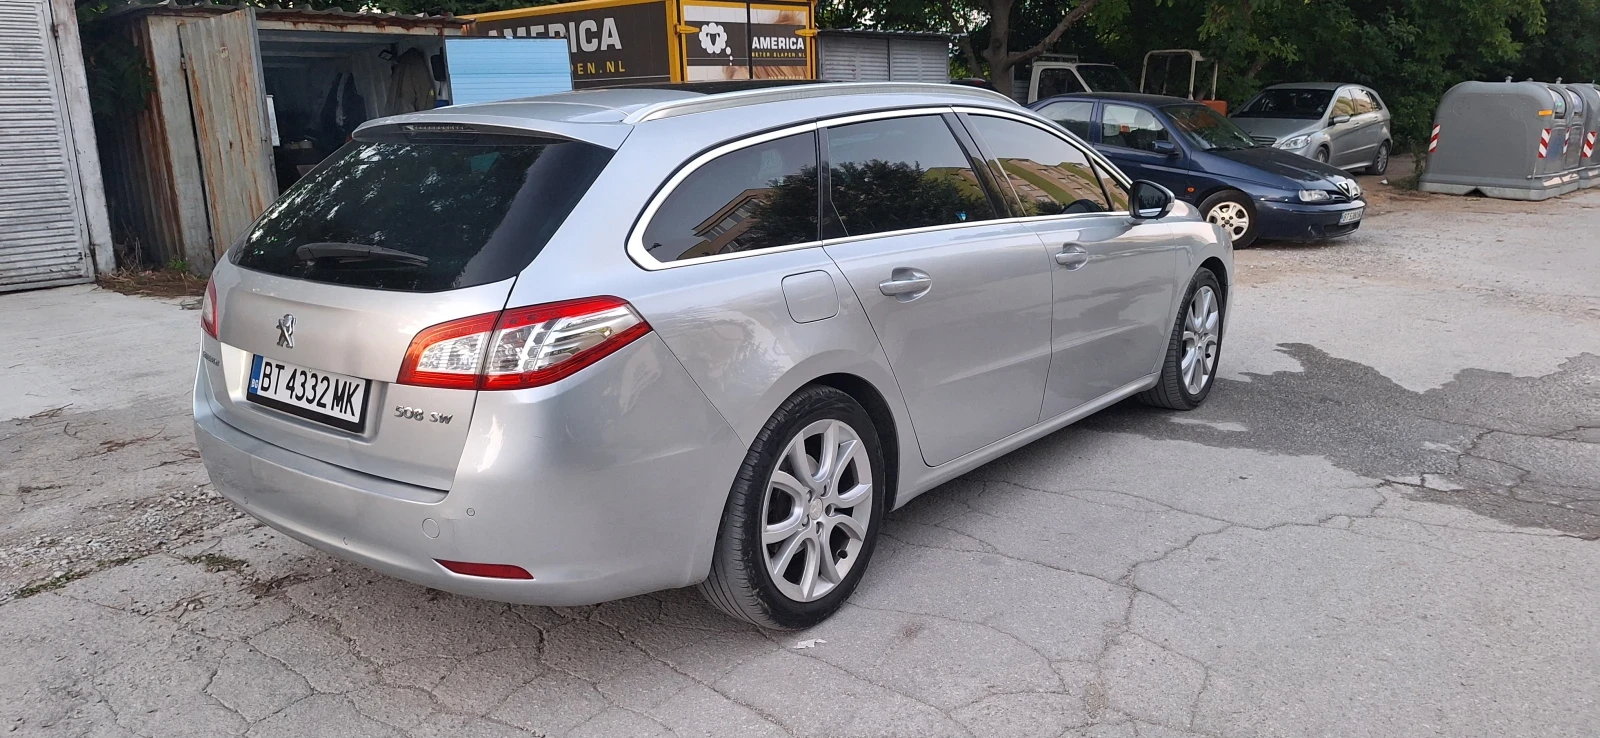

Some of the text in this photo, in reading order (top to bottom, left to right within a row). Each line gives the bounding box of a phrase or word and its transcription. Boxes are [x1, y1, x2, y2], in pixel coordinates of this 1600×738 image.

[752, 36, 805, 50] AMERICA
[260, 361, 361, 417] BT 4332 MK
[394, 404, 453, 424] 508 SW
